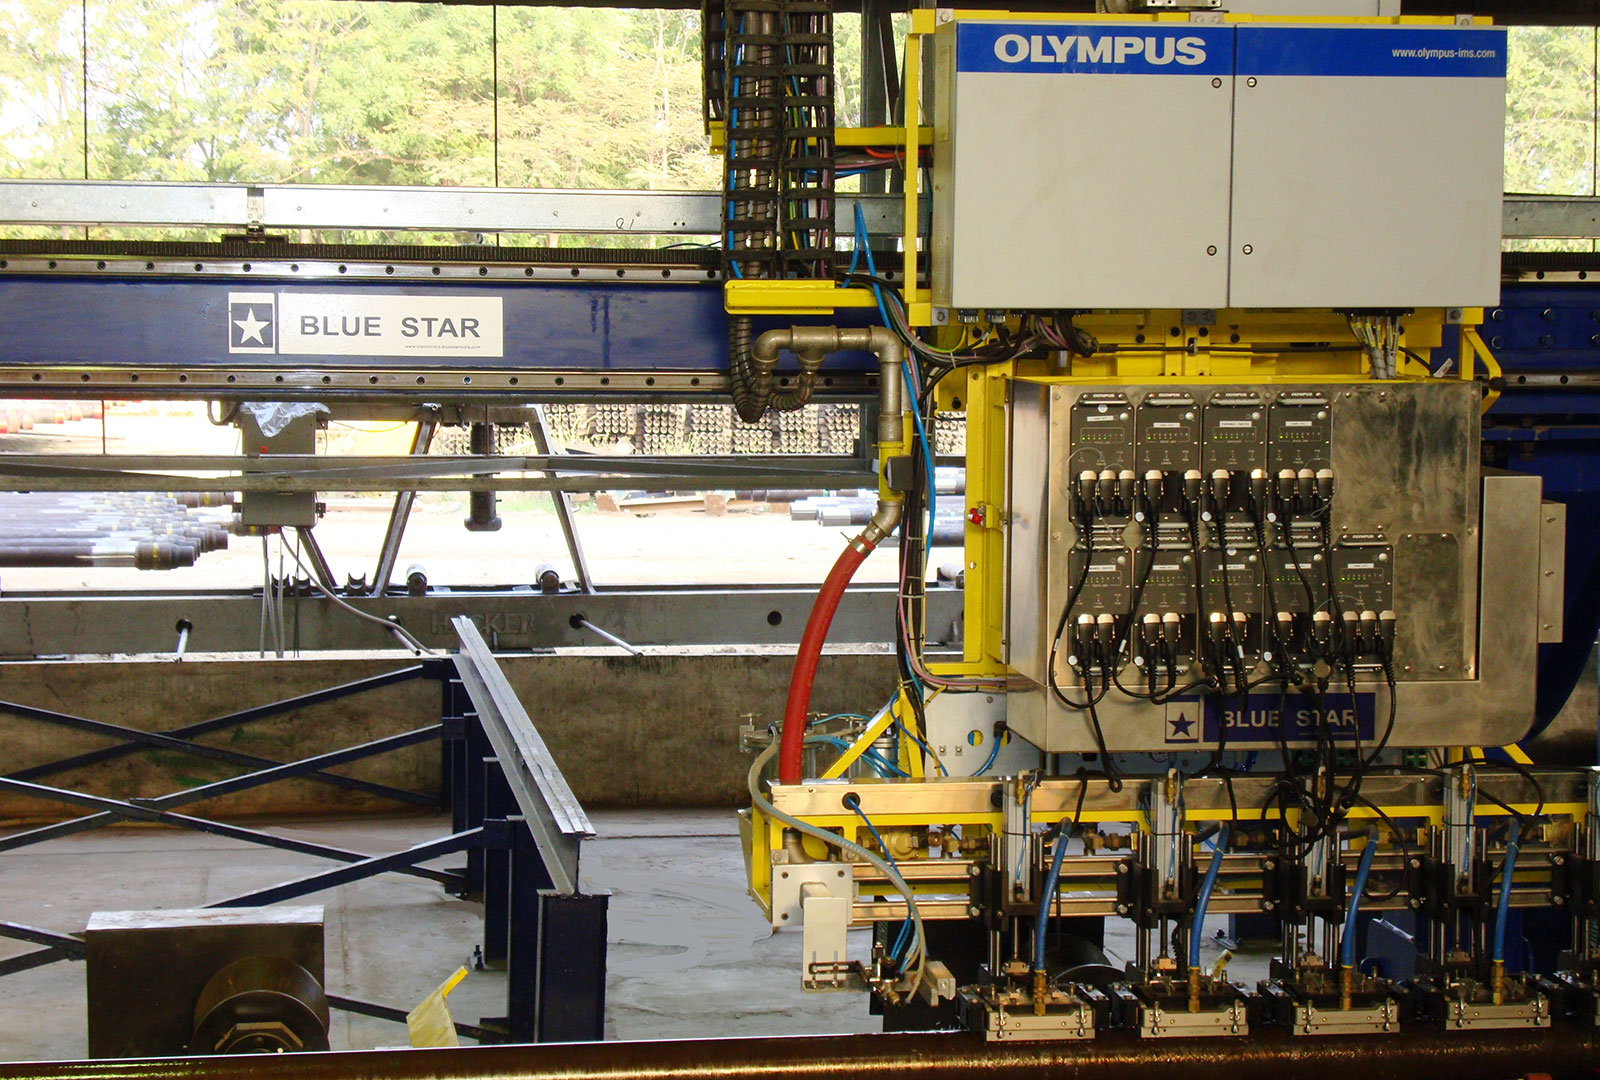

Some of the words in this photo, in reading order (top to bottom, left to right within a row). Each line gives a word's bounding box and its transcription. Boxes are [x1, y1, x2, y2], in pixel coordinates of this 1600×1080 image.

[994, 33, 1207, 66] OLYMPUS
[1392, 47, 1496, 61] www.olympus-ims.com
[300, 315, 382, 337] BLUE
[400, 317, 481, 338] STAR
[431, 612, 536, 634] HCKER
[1223, 710, 1280, 728] BLUE
[1296, 709, 1355, 727] STAR
